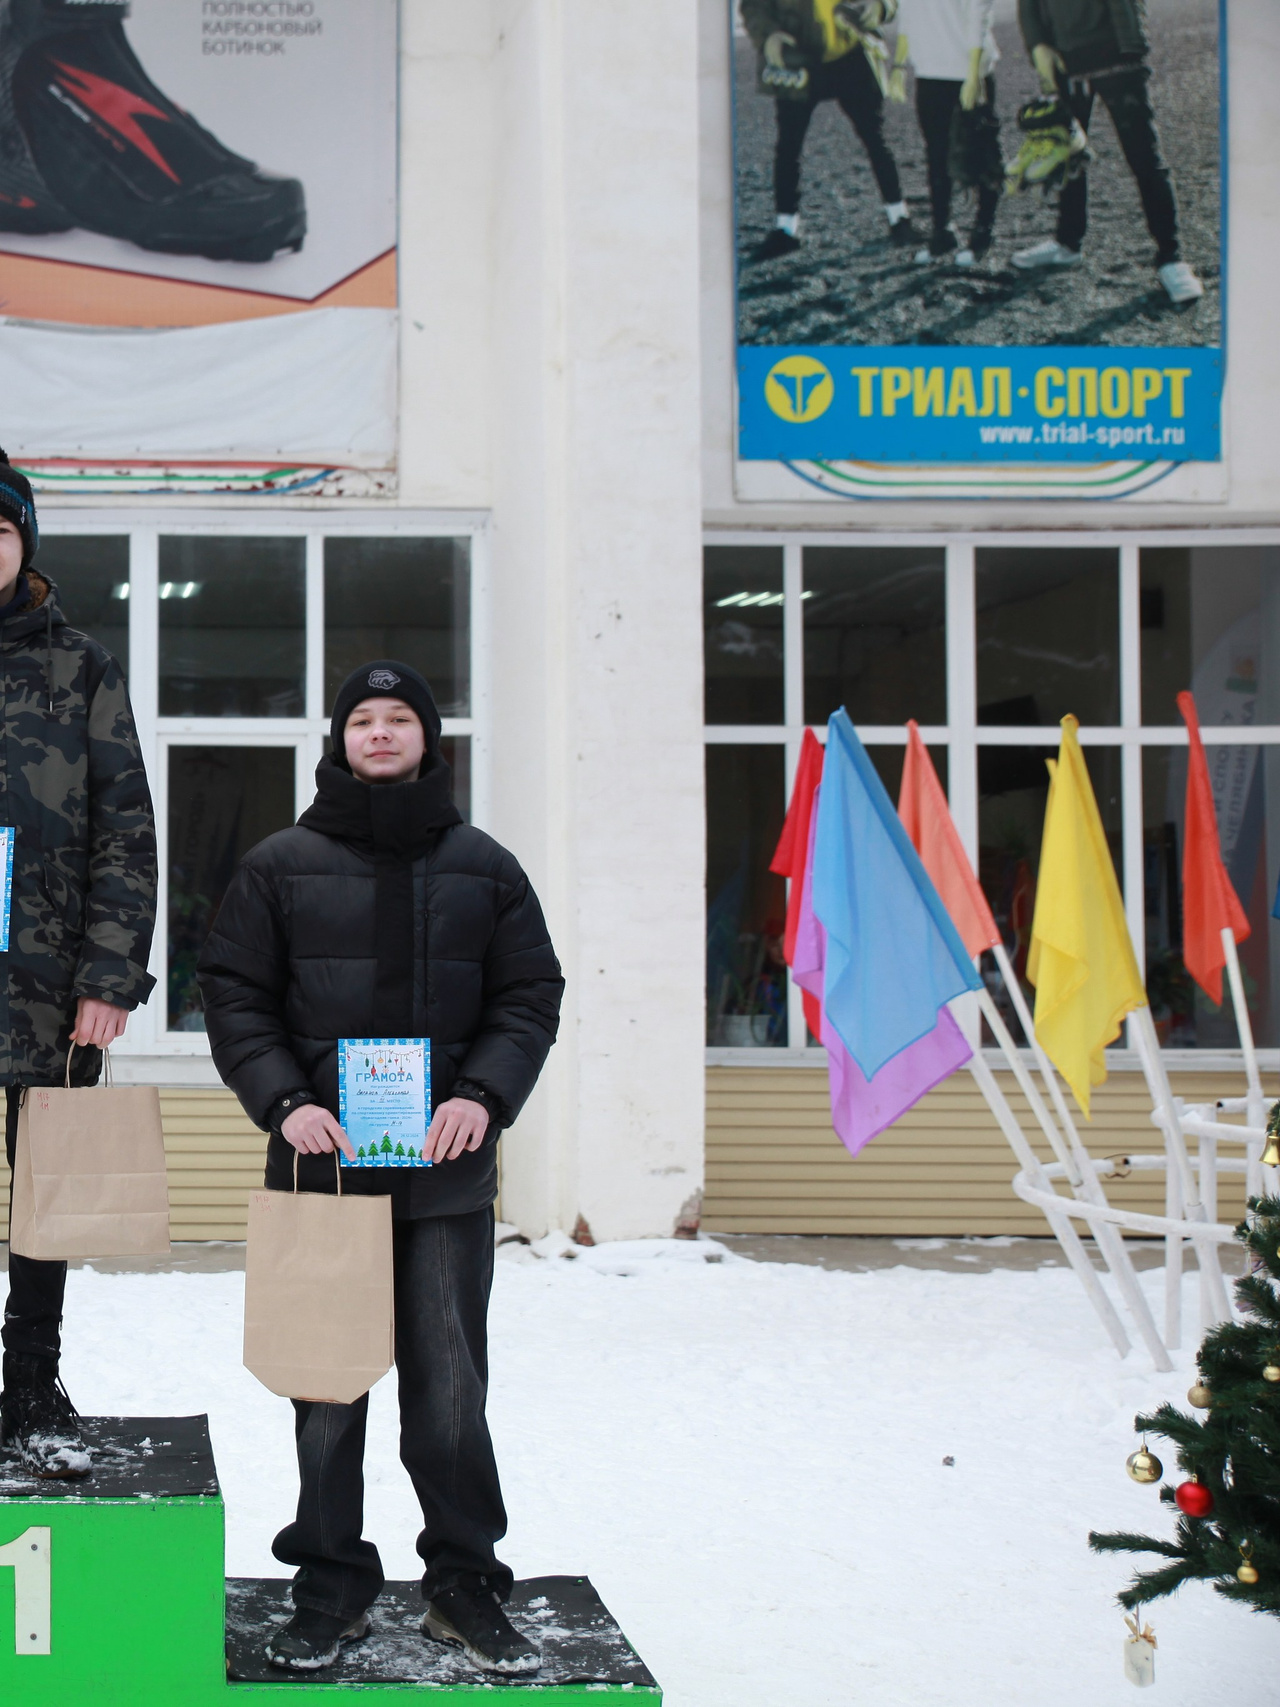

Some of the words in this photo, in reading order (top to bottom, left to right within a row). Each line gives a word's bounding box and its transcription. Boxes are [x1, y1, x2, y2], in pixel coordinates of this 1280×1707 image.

[201, 0, 315, 17] ПОЛНОСТЬЮ
[201, 18, 322, 37] КАРБОНОВЫЙ
[201, 39, 286, 56] БОТИНОК
[979, 421, 1186, 449] www.trial-sport.ru
[1212, 709, 1235, 793] СПОУ
[1226, 700, 1257, 842] ЧЕЛЯБИНКА
[355, 1072, 414, 1083] ГРАМОТА
